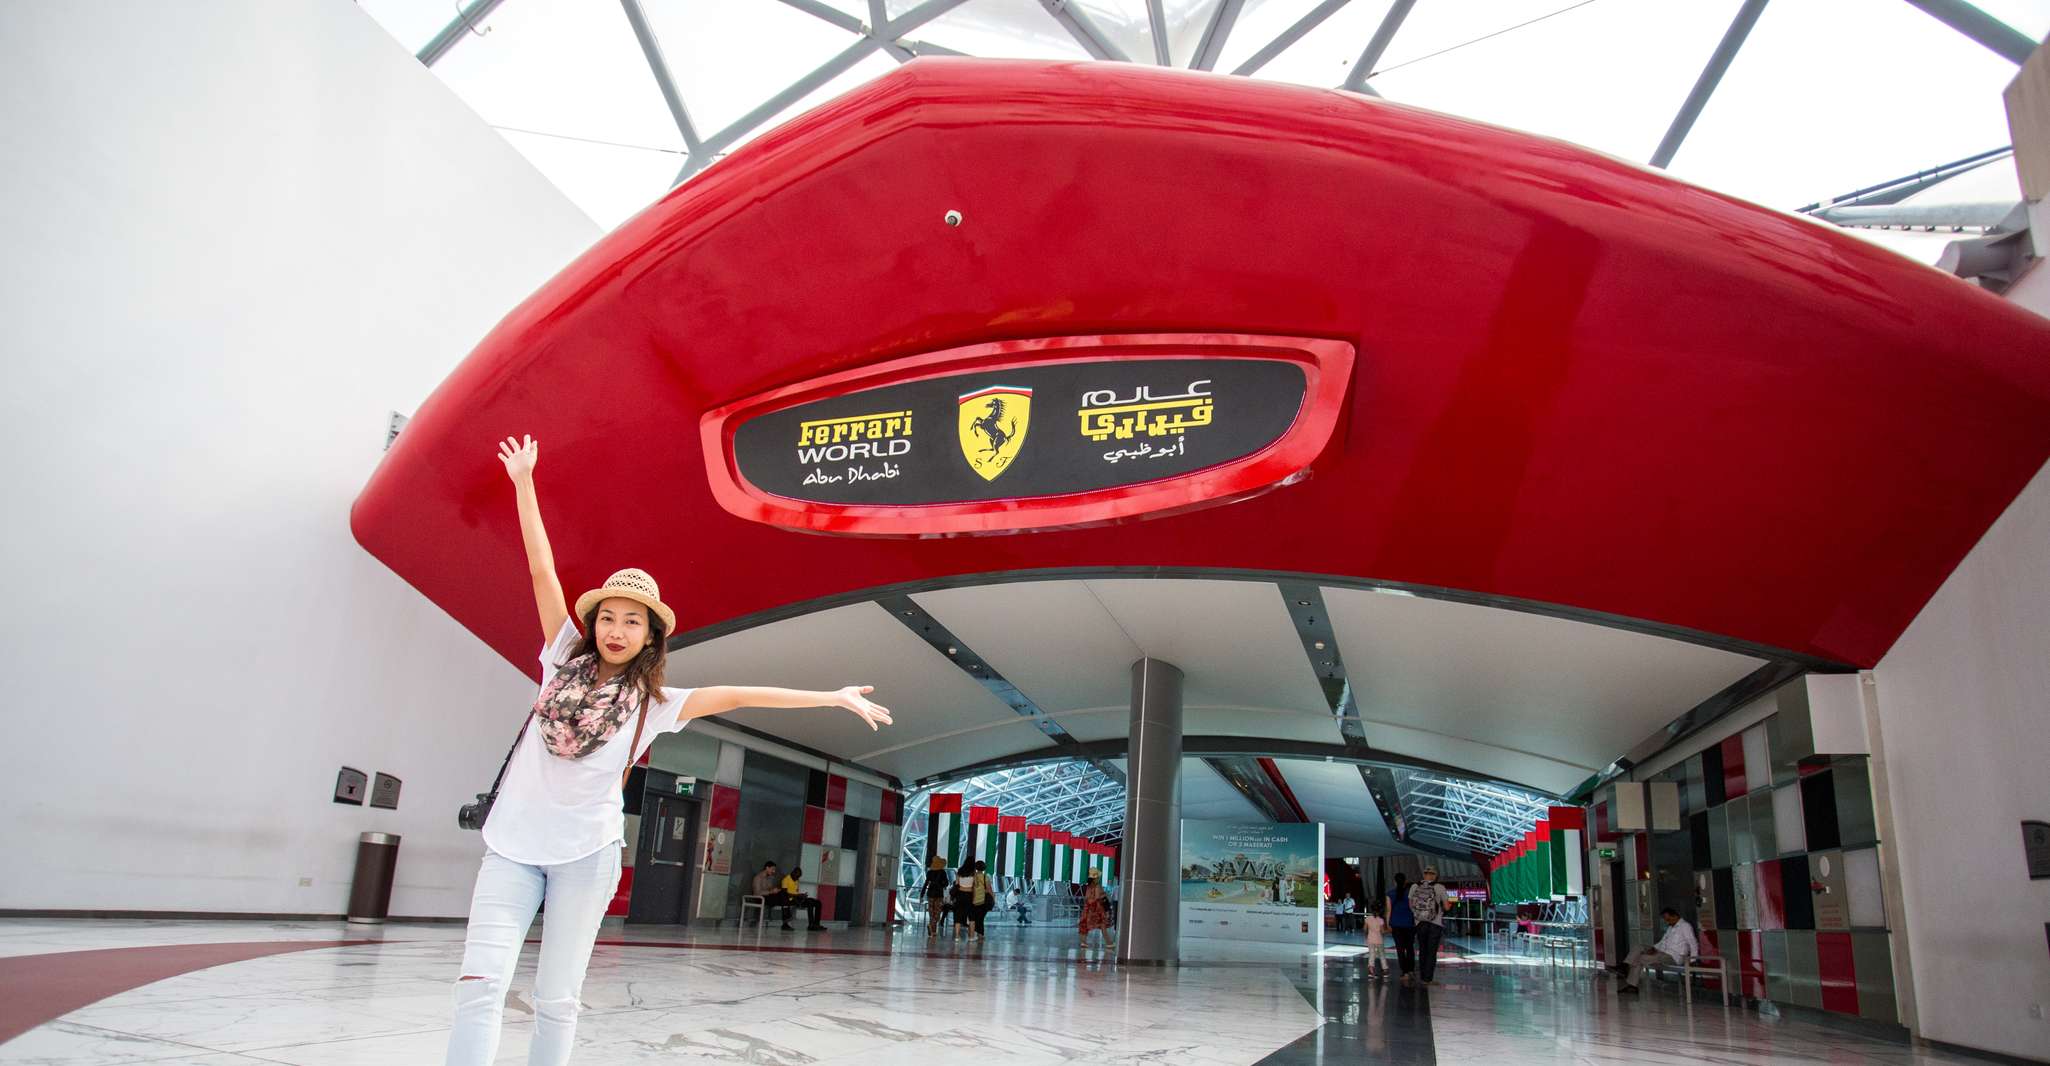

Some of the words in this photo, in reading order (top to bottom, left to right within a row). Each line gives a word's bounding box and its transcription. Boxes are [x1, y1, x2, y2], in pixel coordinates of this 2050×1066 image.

[1081, 379, 1212, 408] عالم
[798, 410, 913, 447] Ferrari
[1078, 398, 1214, 441] فيراري
[797, 439, 912, 465] WORLD
[973, 457, 983, 470] S
[1103, 442, 1152, 463] ظبي
[802, 467, 843, 486] Abu
[847, 461, 900, 485] Dhabi
